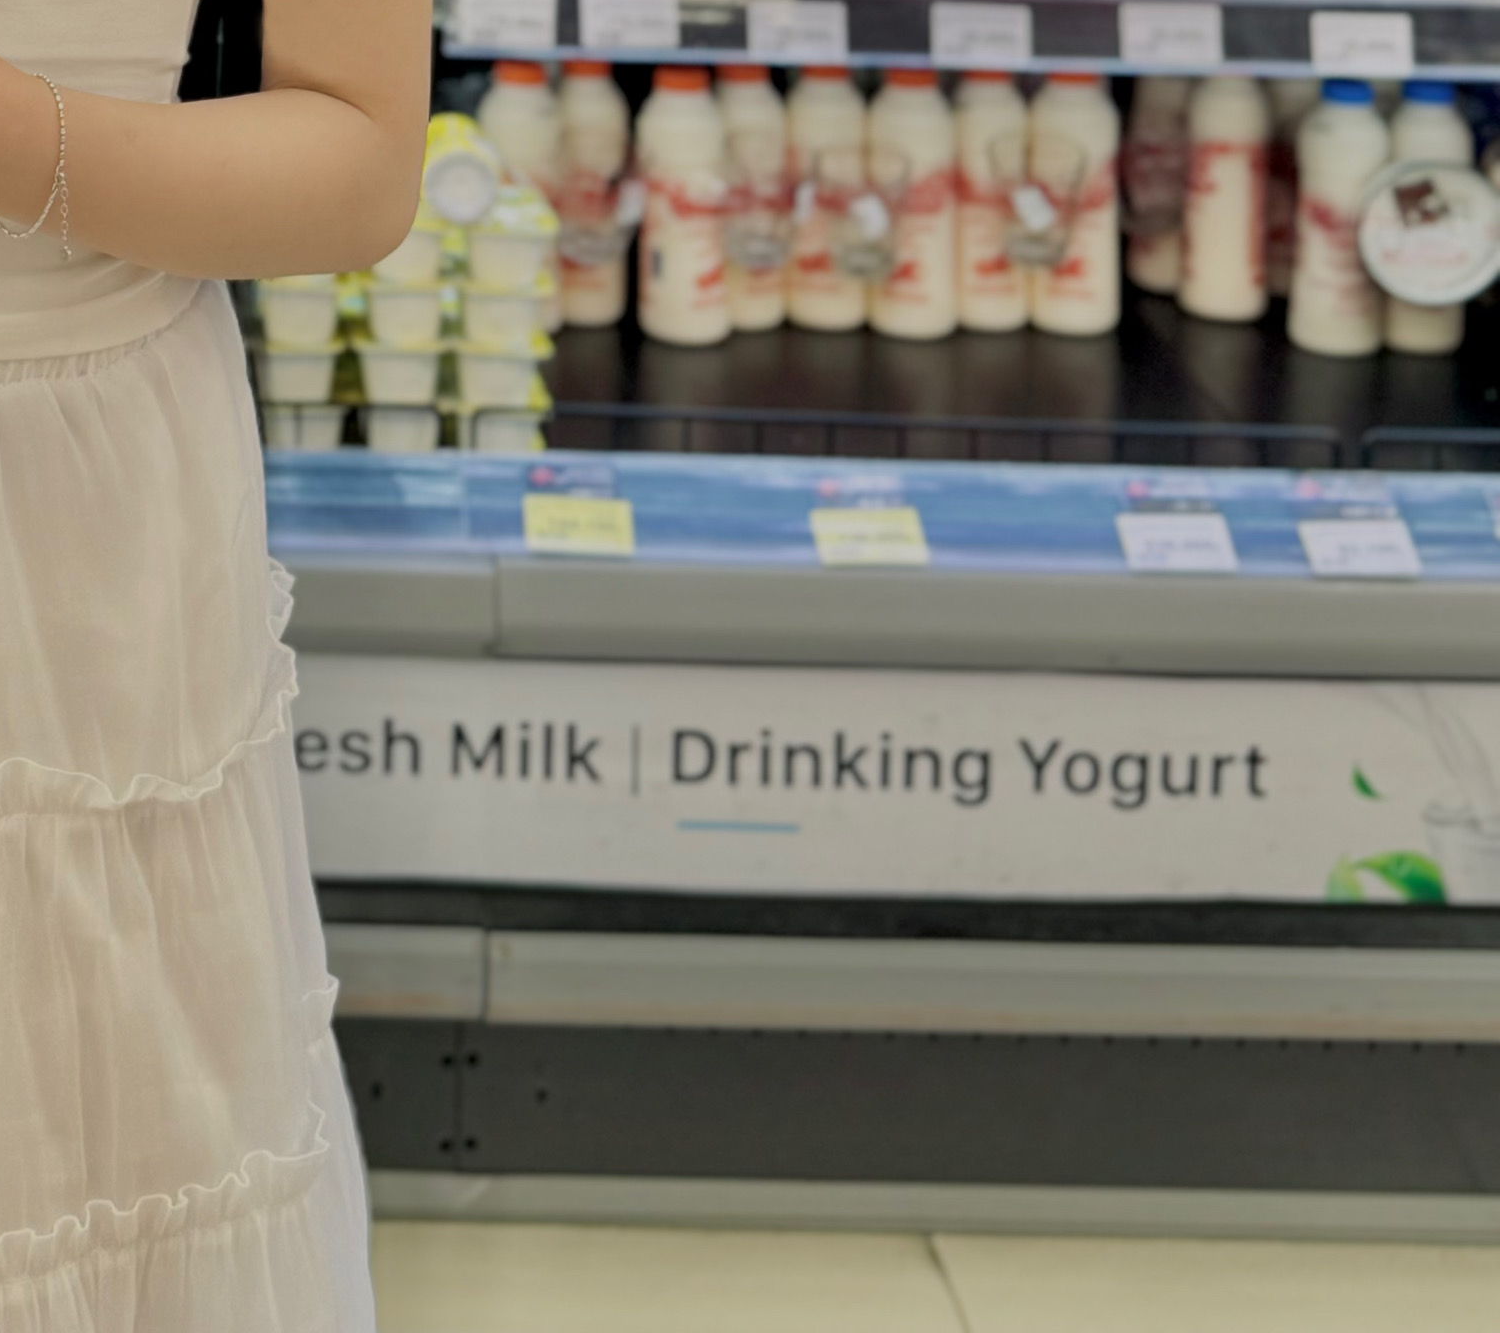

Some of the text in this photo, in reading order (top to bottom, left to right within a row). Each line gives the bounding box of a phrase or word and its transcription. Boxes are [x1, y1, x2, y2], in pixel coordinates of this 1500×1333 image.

[294, 716, 1269, 812] esh Milk Drinking Yogurt
